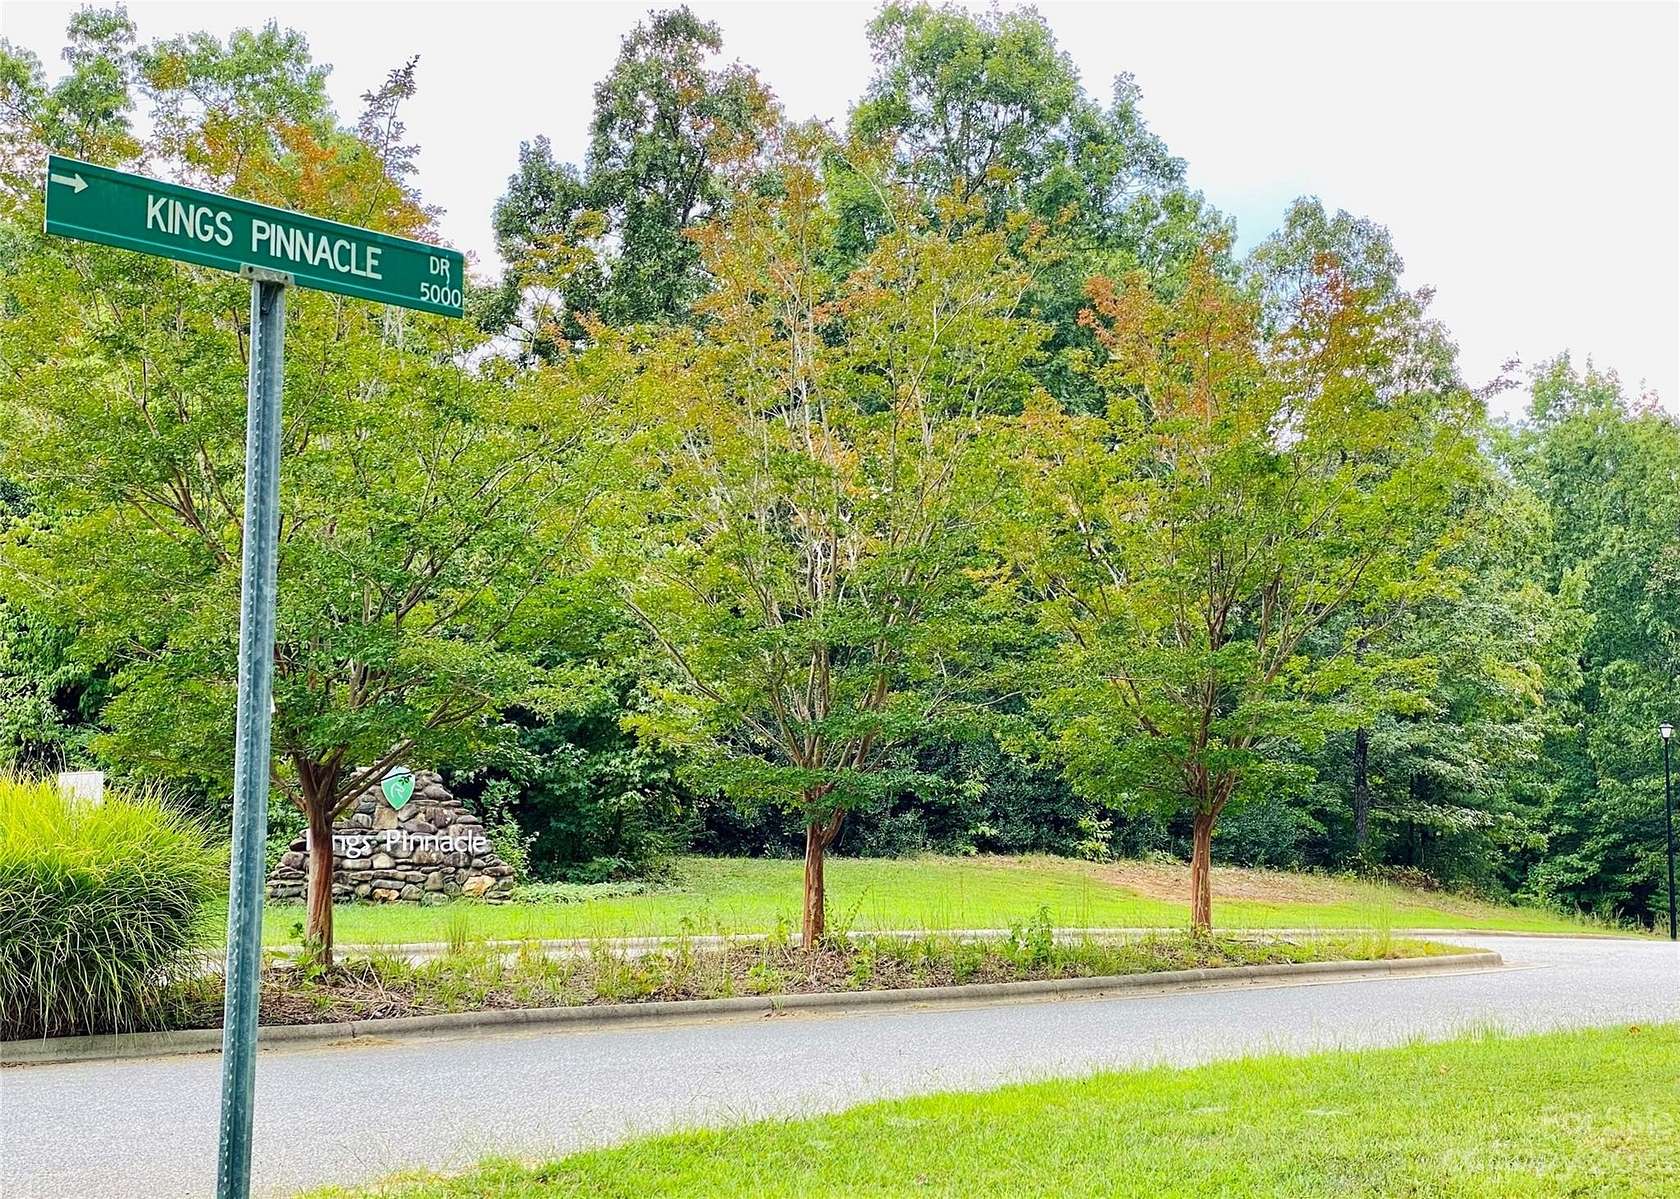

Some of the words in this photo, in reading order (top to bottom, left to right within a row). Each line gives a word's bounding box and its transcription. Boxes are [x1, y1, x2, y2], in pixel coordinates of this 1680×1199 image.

[146, 194, 234, 247] KINGS
[251, 219, 383, 280] PINNACLE
[430, 255, 450, 277] DR
[420, 282, 461, 308] 5000
[306, 829, 372, 859] ngs
[386, 829, 487, 853] Pinnacle
